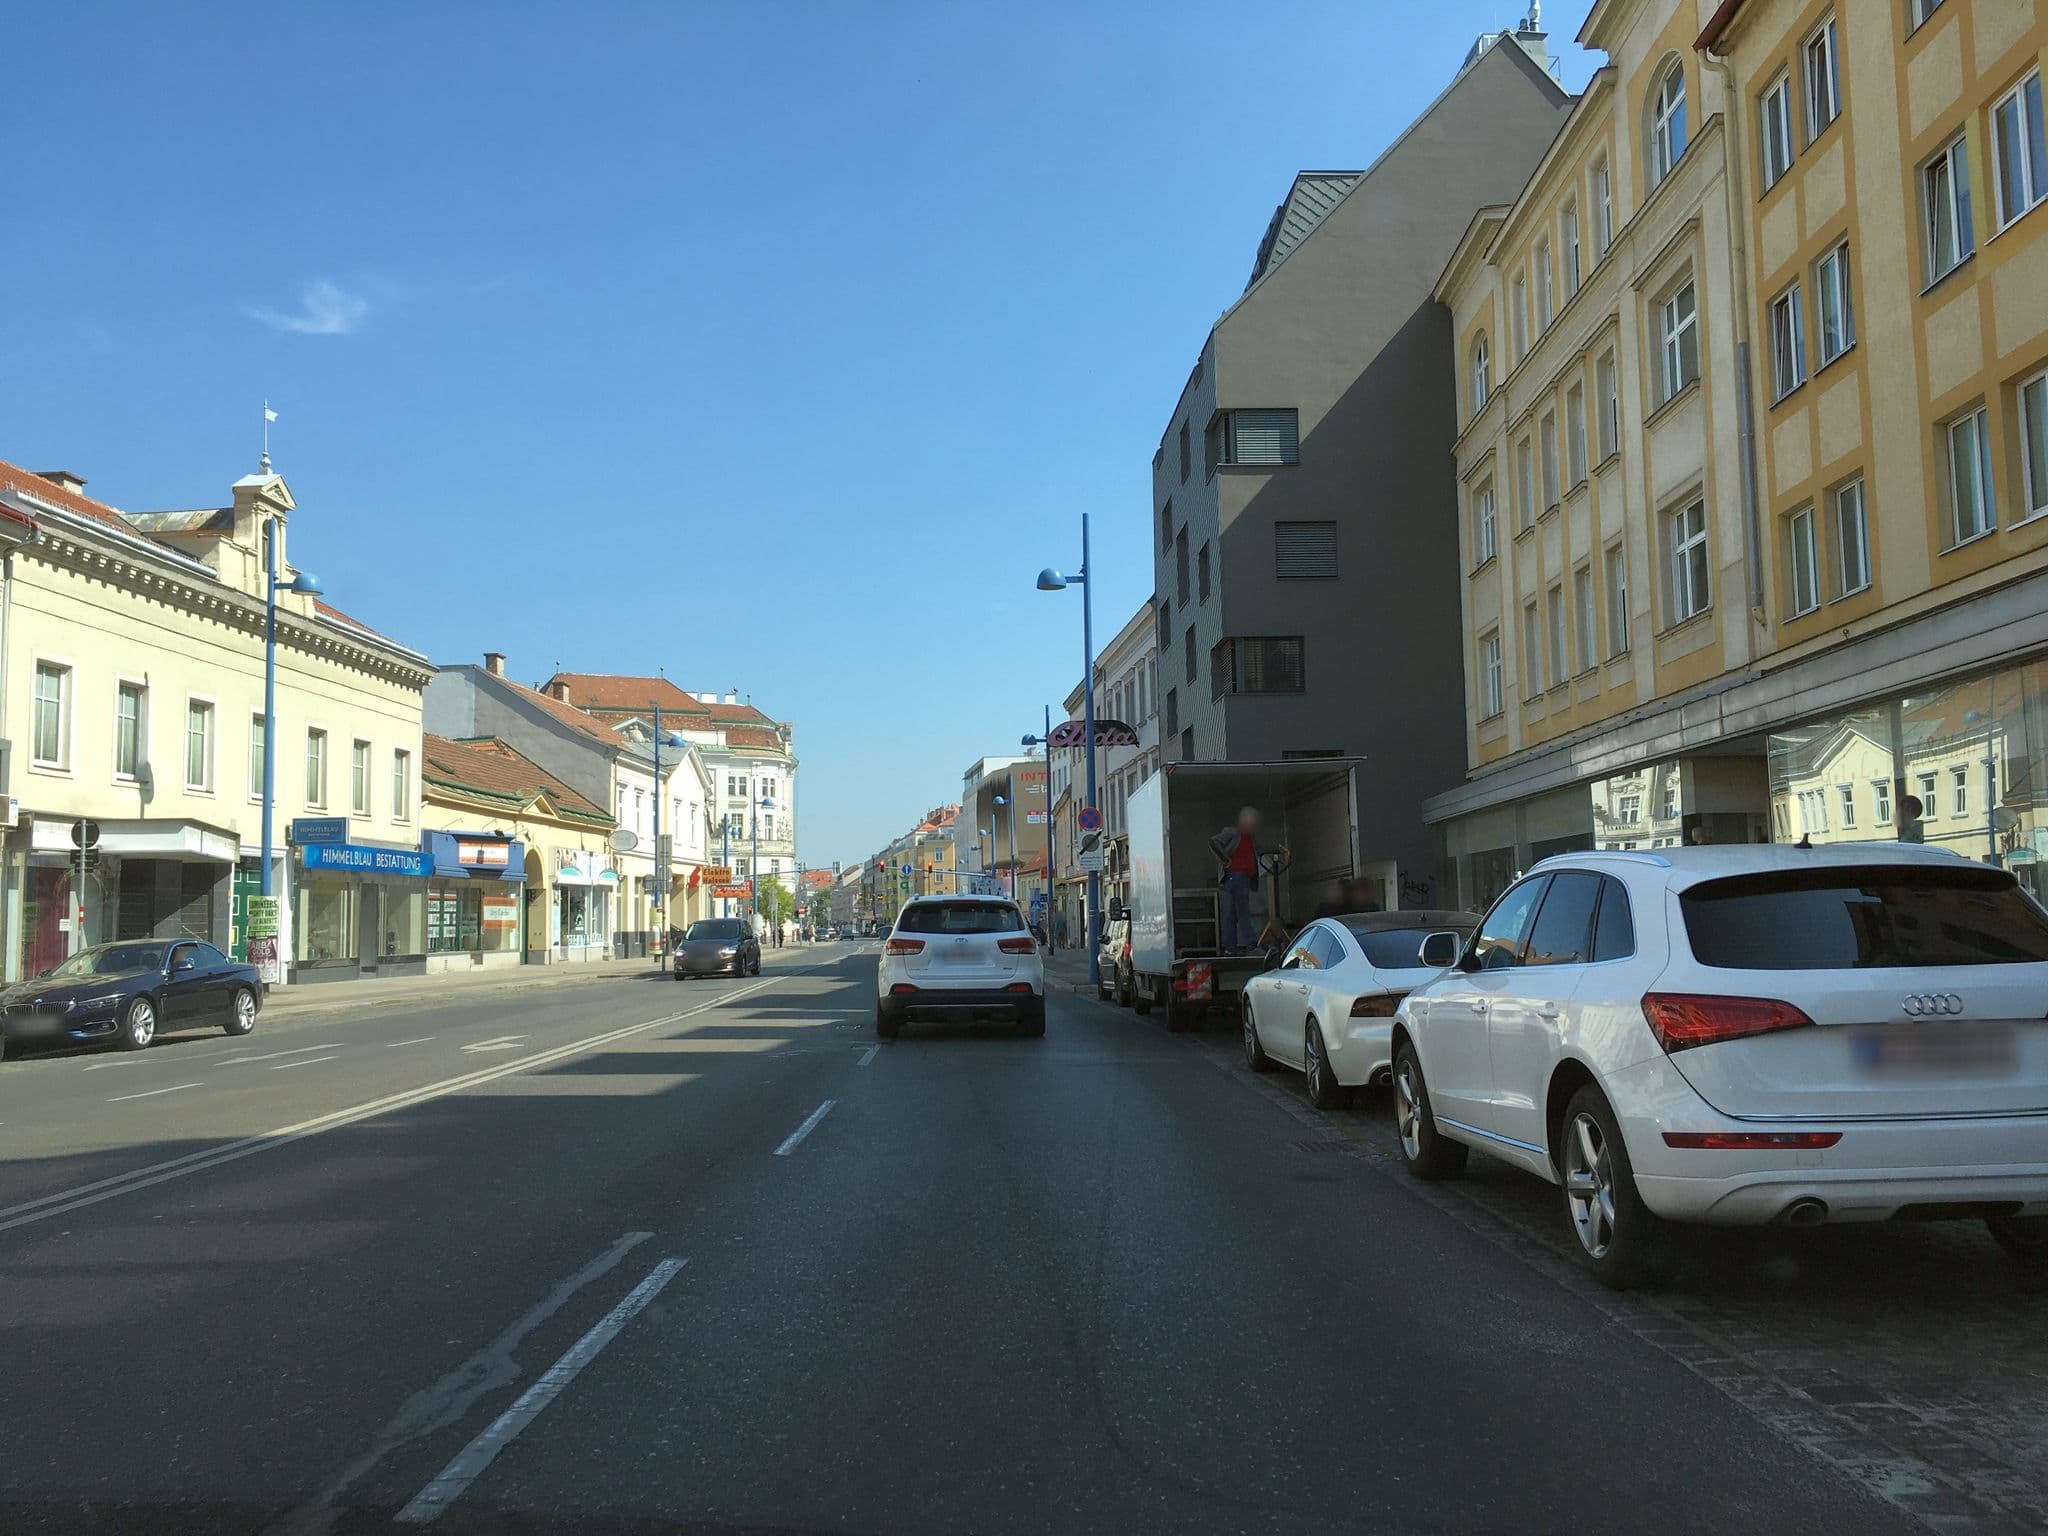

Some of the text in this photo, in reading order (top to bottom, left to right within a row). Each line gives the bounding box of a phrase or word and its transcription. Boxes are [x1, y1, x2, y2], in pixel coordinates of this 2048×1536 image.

[322, 848, 421, 870] HIMMELBLAU BESTATTUNG
[703, 868, 730, 876] Elektro
